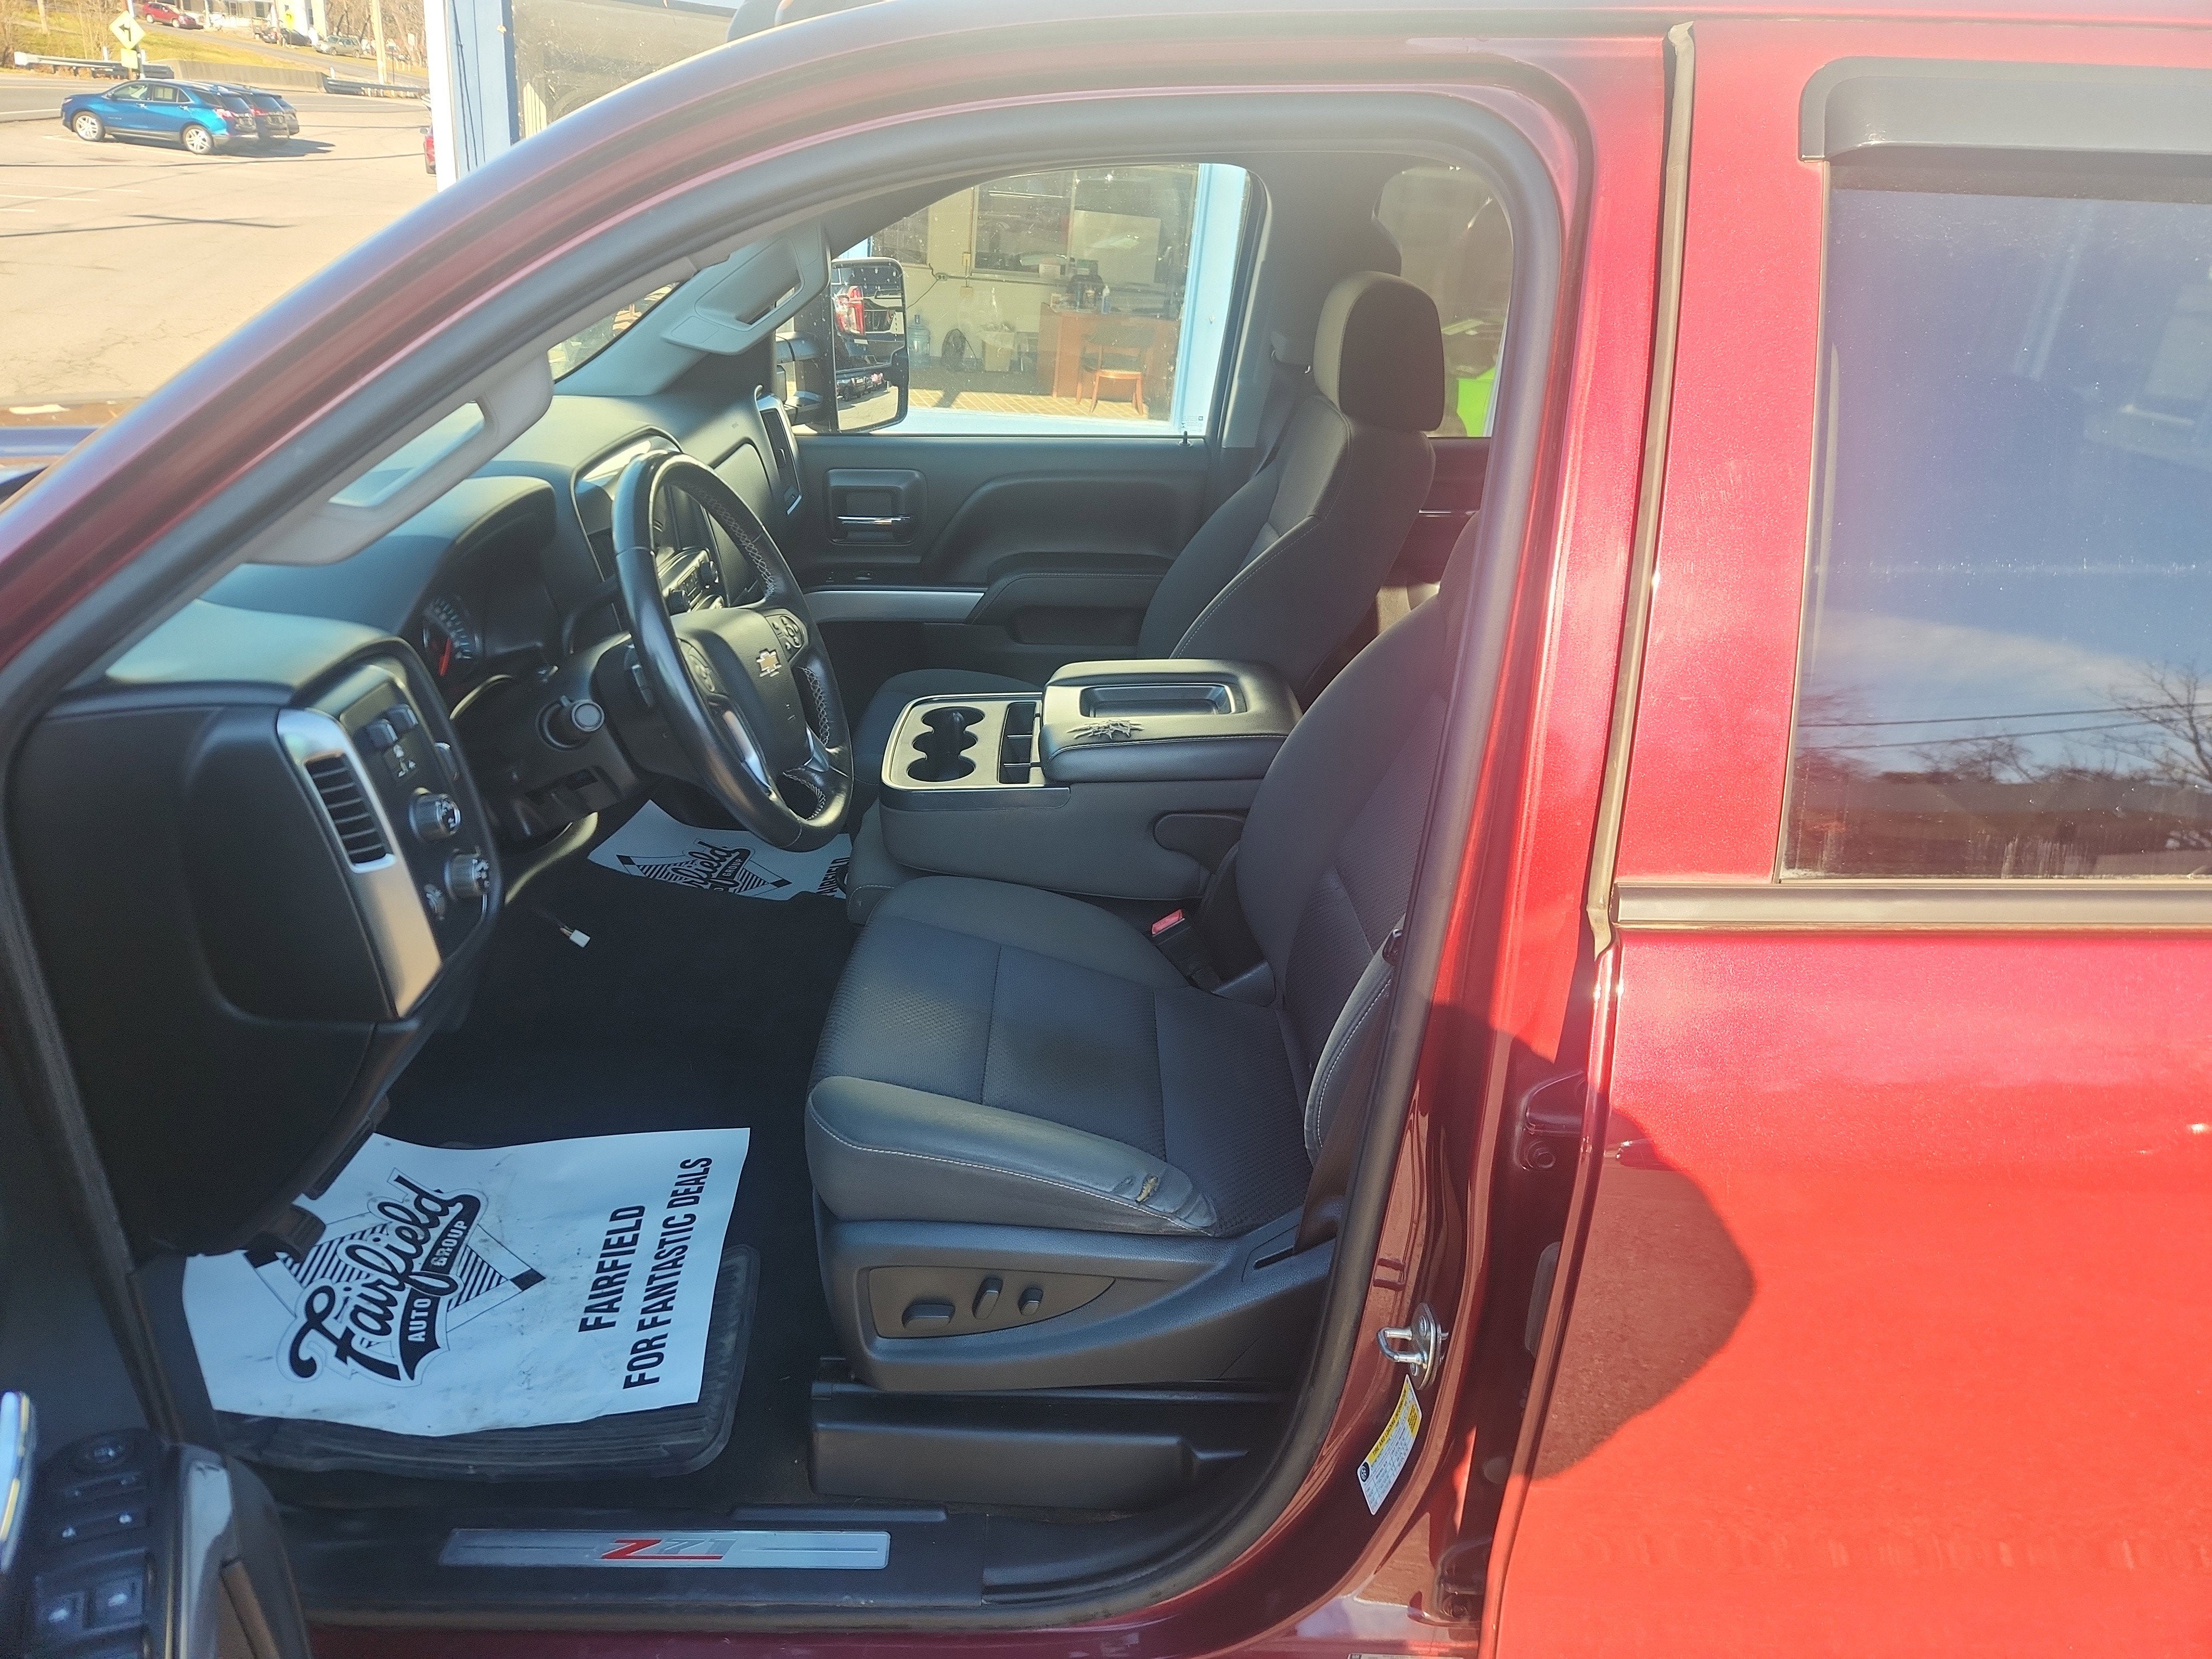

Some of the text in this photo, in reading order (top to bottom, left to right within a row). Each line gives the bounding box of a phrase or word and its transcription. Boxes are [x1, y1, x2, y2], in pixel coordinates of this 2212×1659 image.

[722, 858, 743, 877] GROUP
[290, 1175, 481, 1381] Fairfield
[408, 1220, 467, 1342] AUTO GROUP
[578, 1205, 645, 1333] FAIRFIELD
[622, 1157, 713, 1390] FOR FANTASTIC DEALS
[601, 1538, 738, 1560] Z71
